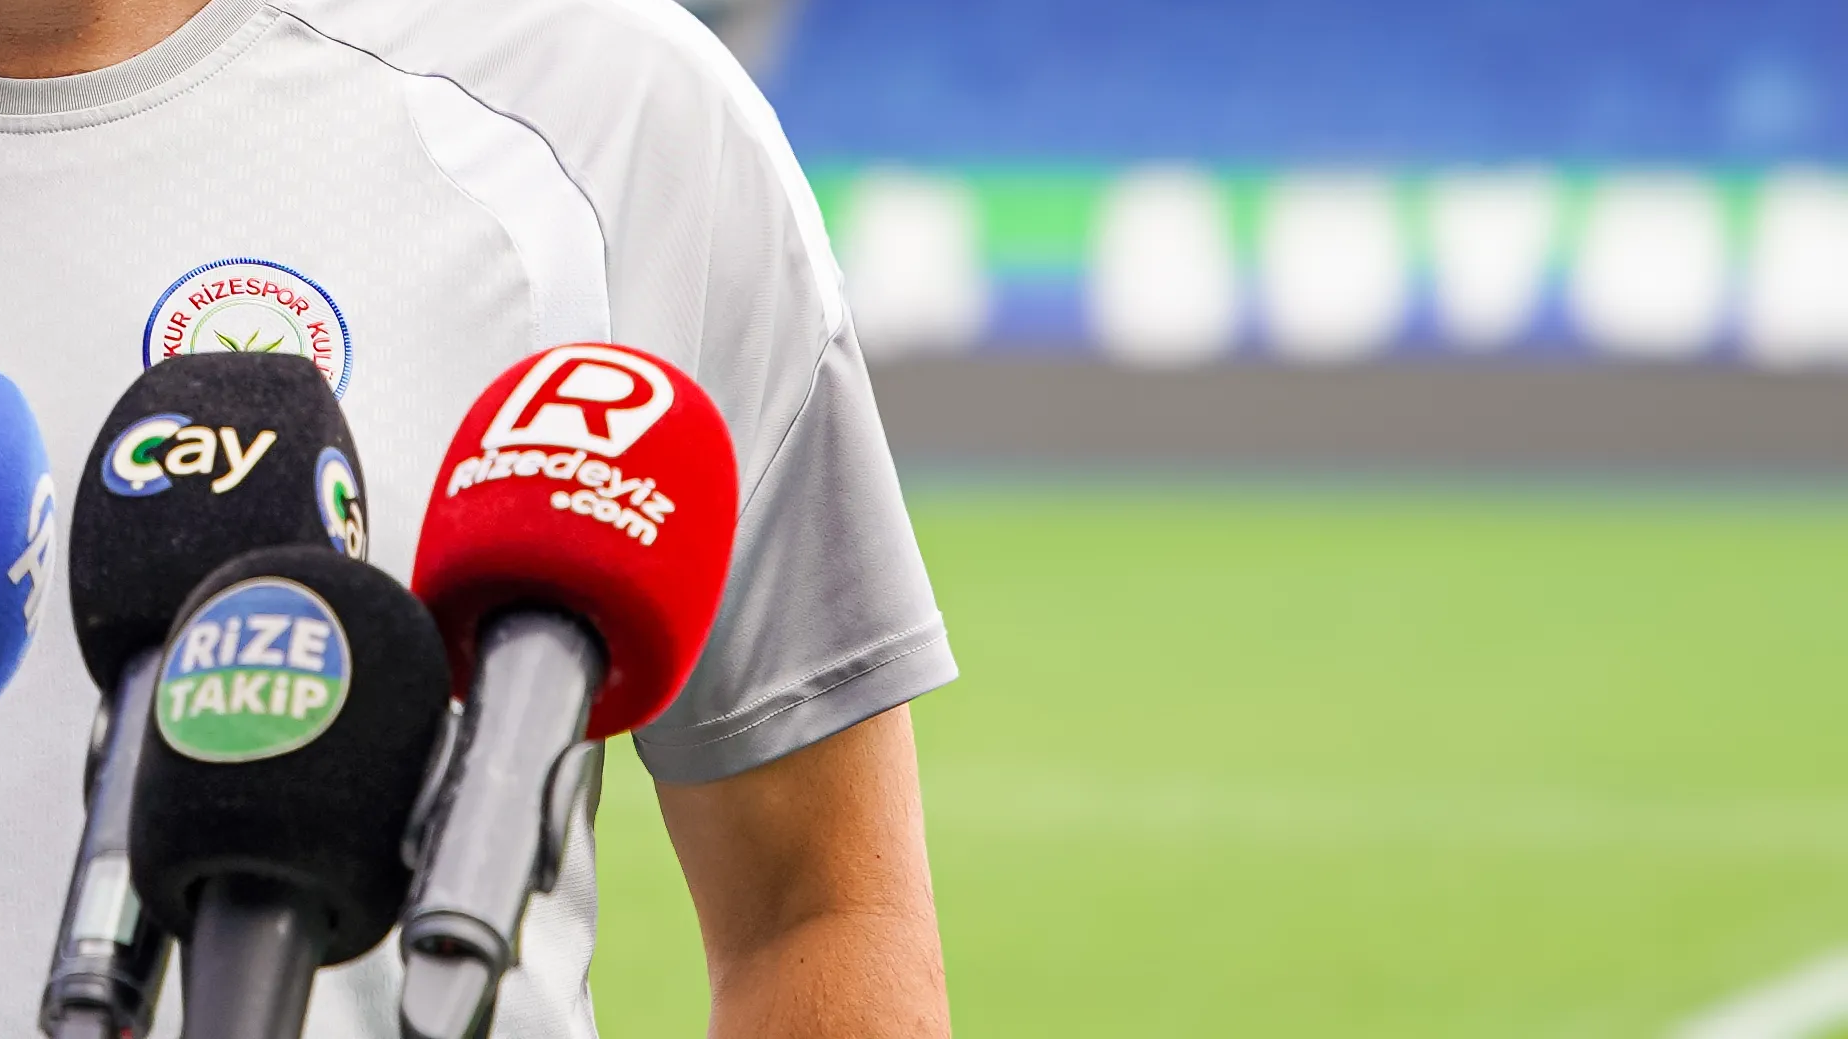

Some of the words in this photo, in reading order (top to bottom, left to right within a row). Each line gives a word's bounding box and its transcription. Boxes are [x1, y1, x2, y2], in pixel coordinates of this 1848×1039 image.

[163, 310, 192, 359] KUR
[188, 277, 310, 317] RİZESPOR
[105, 415, 278, 495] Çay
[550, 490, 659, 547] .com
